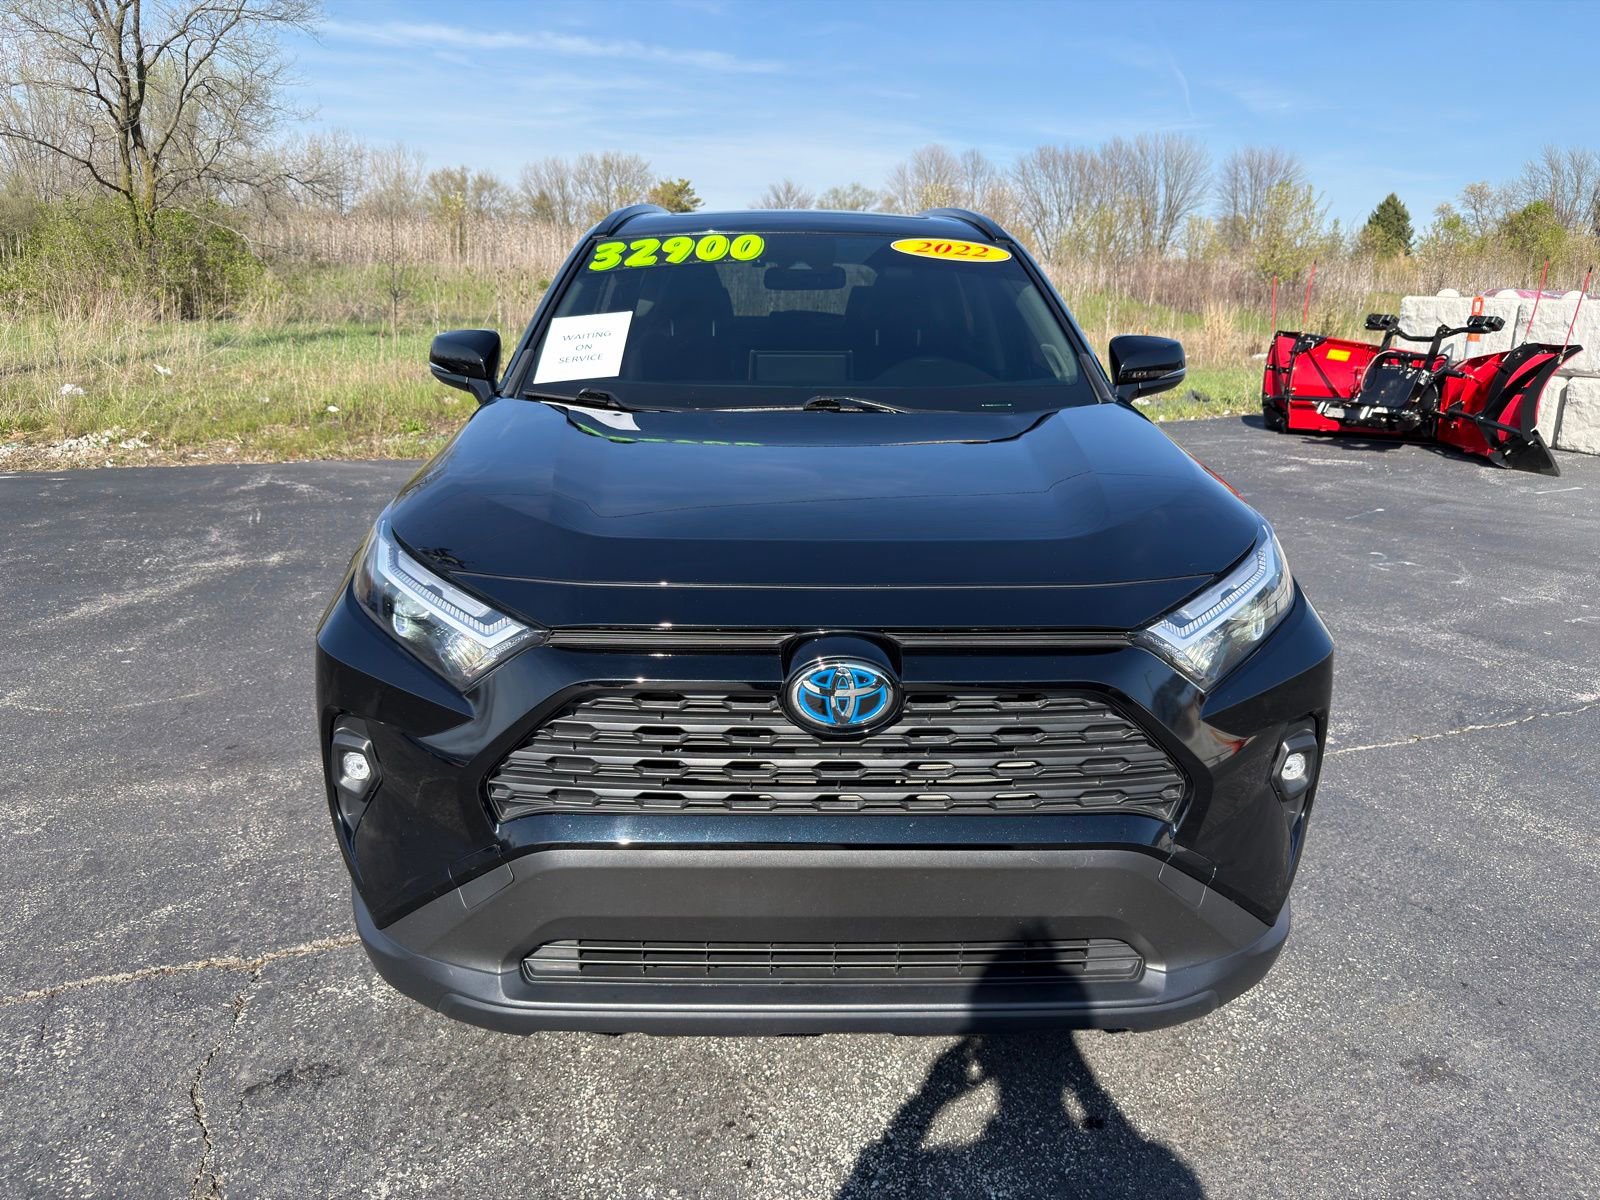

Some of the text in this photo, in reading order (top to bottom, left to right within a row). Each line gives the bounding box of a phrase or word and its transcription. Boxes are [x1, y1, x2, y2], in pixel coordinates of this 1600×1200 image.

[588, 234, 765, 271] 32900
[914, 242, 989, 257] 2022
[562, 330, 612, 341] WAITING
[575, 344, 593, 352] ON
[558, 353, 604, 364] SERVICE
